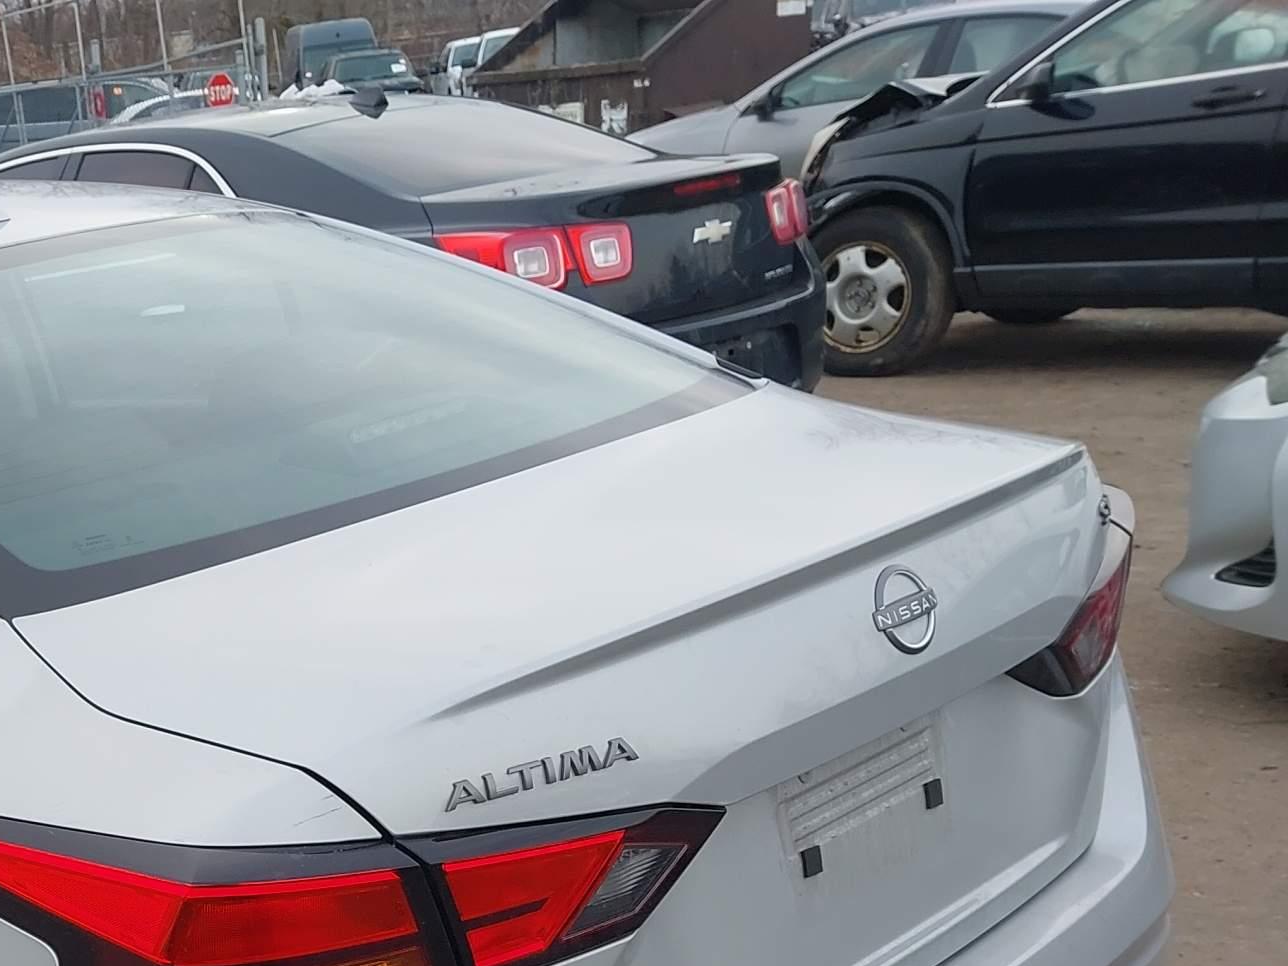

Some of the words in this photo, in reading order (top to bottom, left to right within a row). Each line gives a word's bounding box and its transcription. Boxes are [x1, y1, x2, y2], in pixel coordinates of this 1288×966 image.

[210, 84, 232, 101] STOP
[877, 593, 937, 628] NISSAN
[445, 737, 639, 812] ALTIMA
